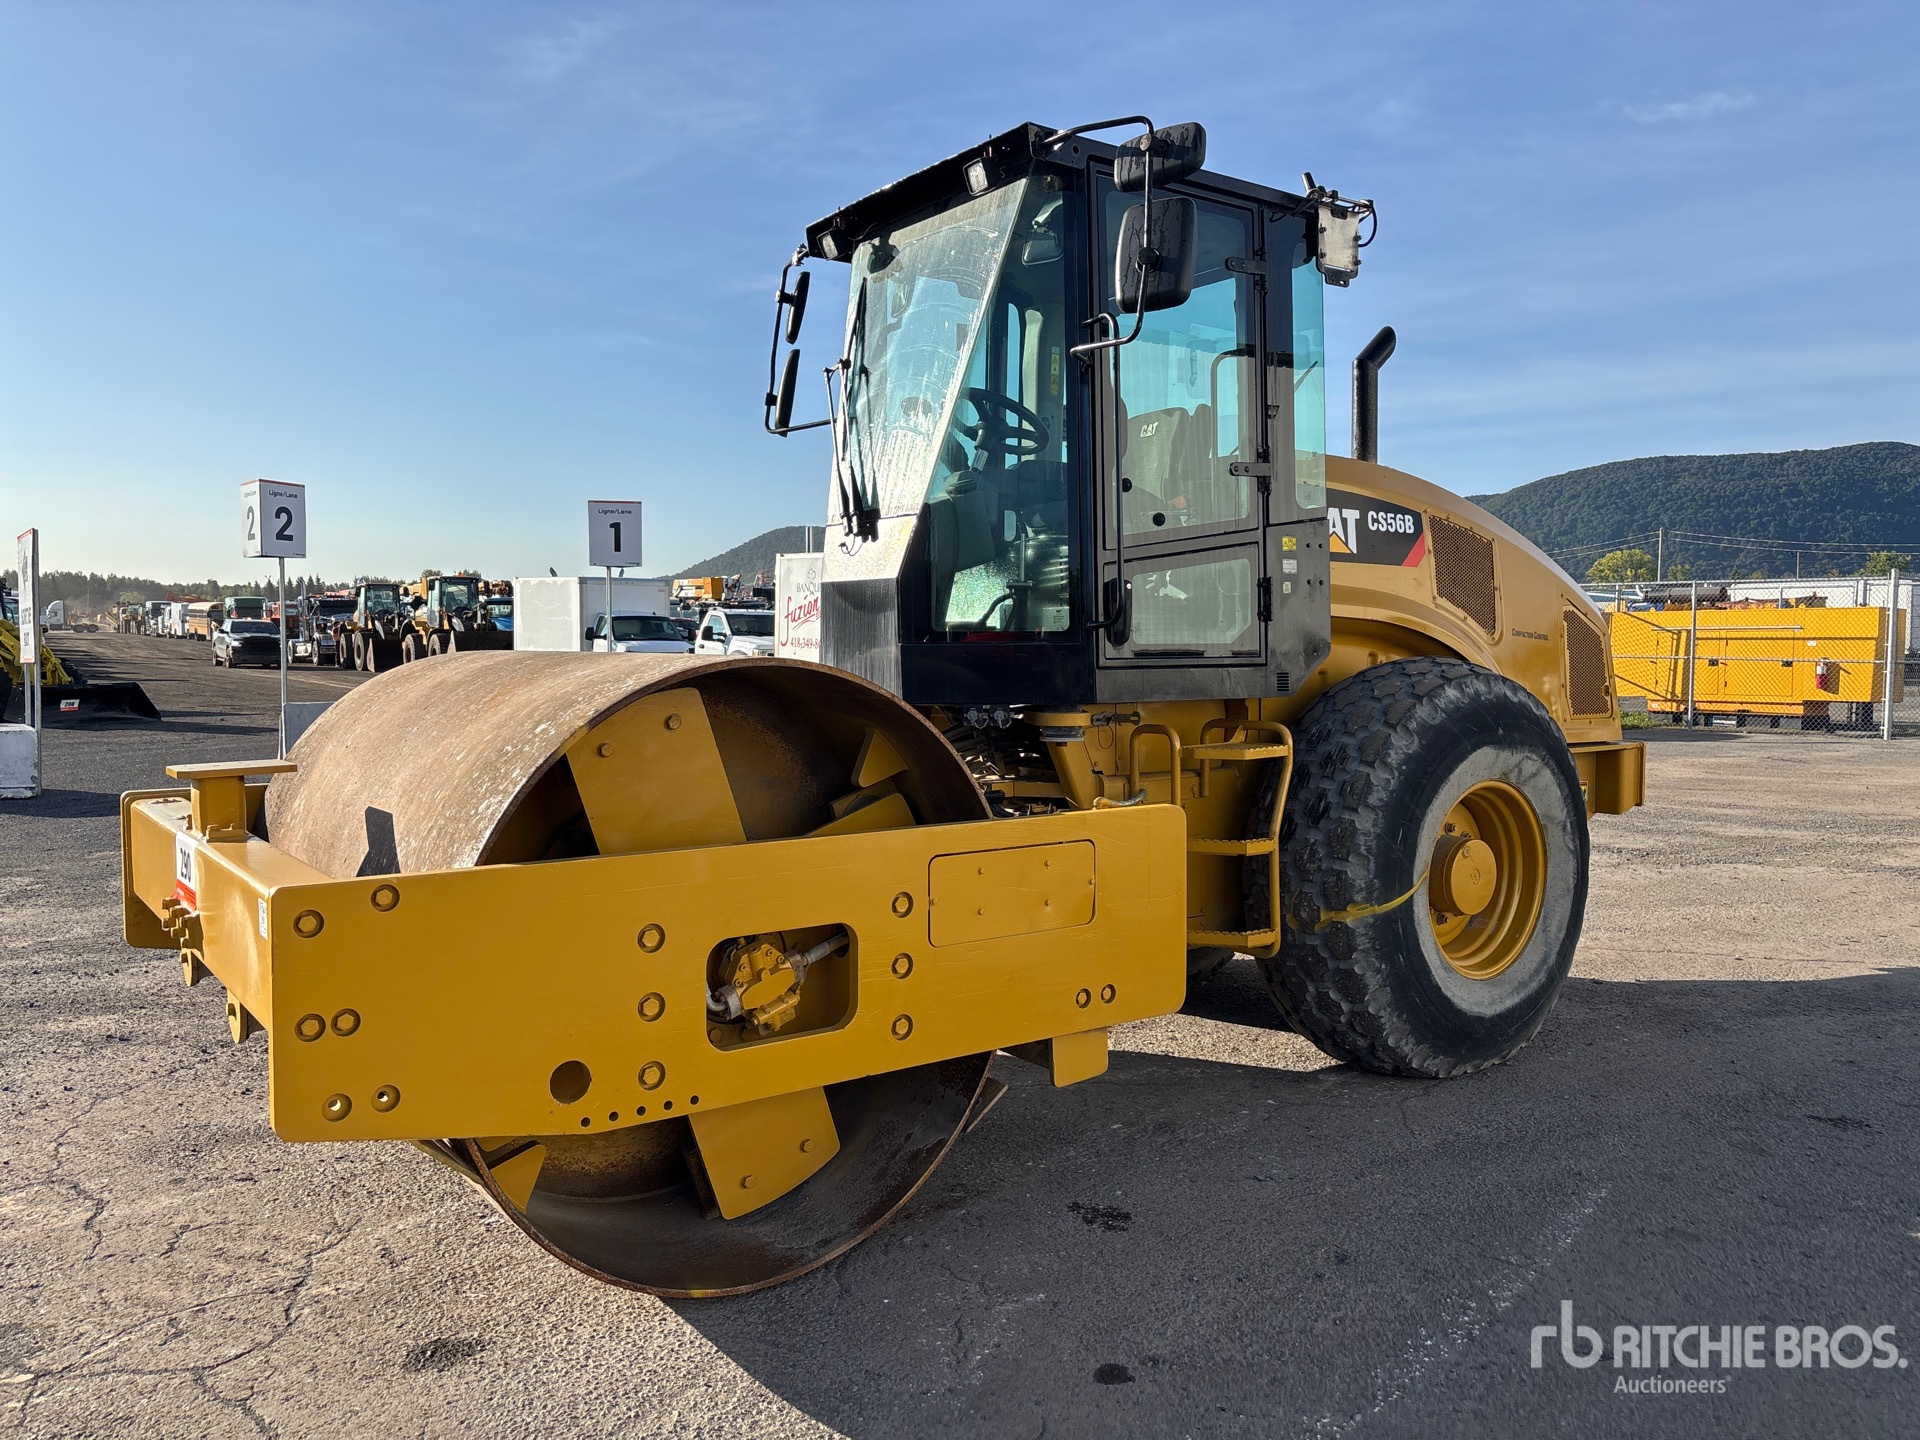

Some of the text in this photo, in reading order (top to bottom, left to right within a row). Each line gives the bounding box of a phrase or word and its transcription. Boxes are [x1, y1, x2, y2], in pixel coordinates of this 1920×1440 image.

[1140, 421, 1158, 438] CAT
[268, 489, 298, 499] Ligne/Lane
[246, 505, 255, 541] 2
[274, 506, 294, 542] 2
[609, 521, 621, 553] 1
[1327, 507, 1415, 554] AT CS56B
